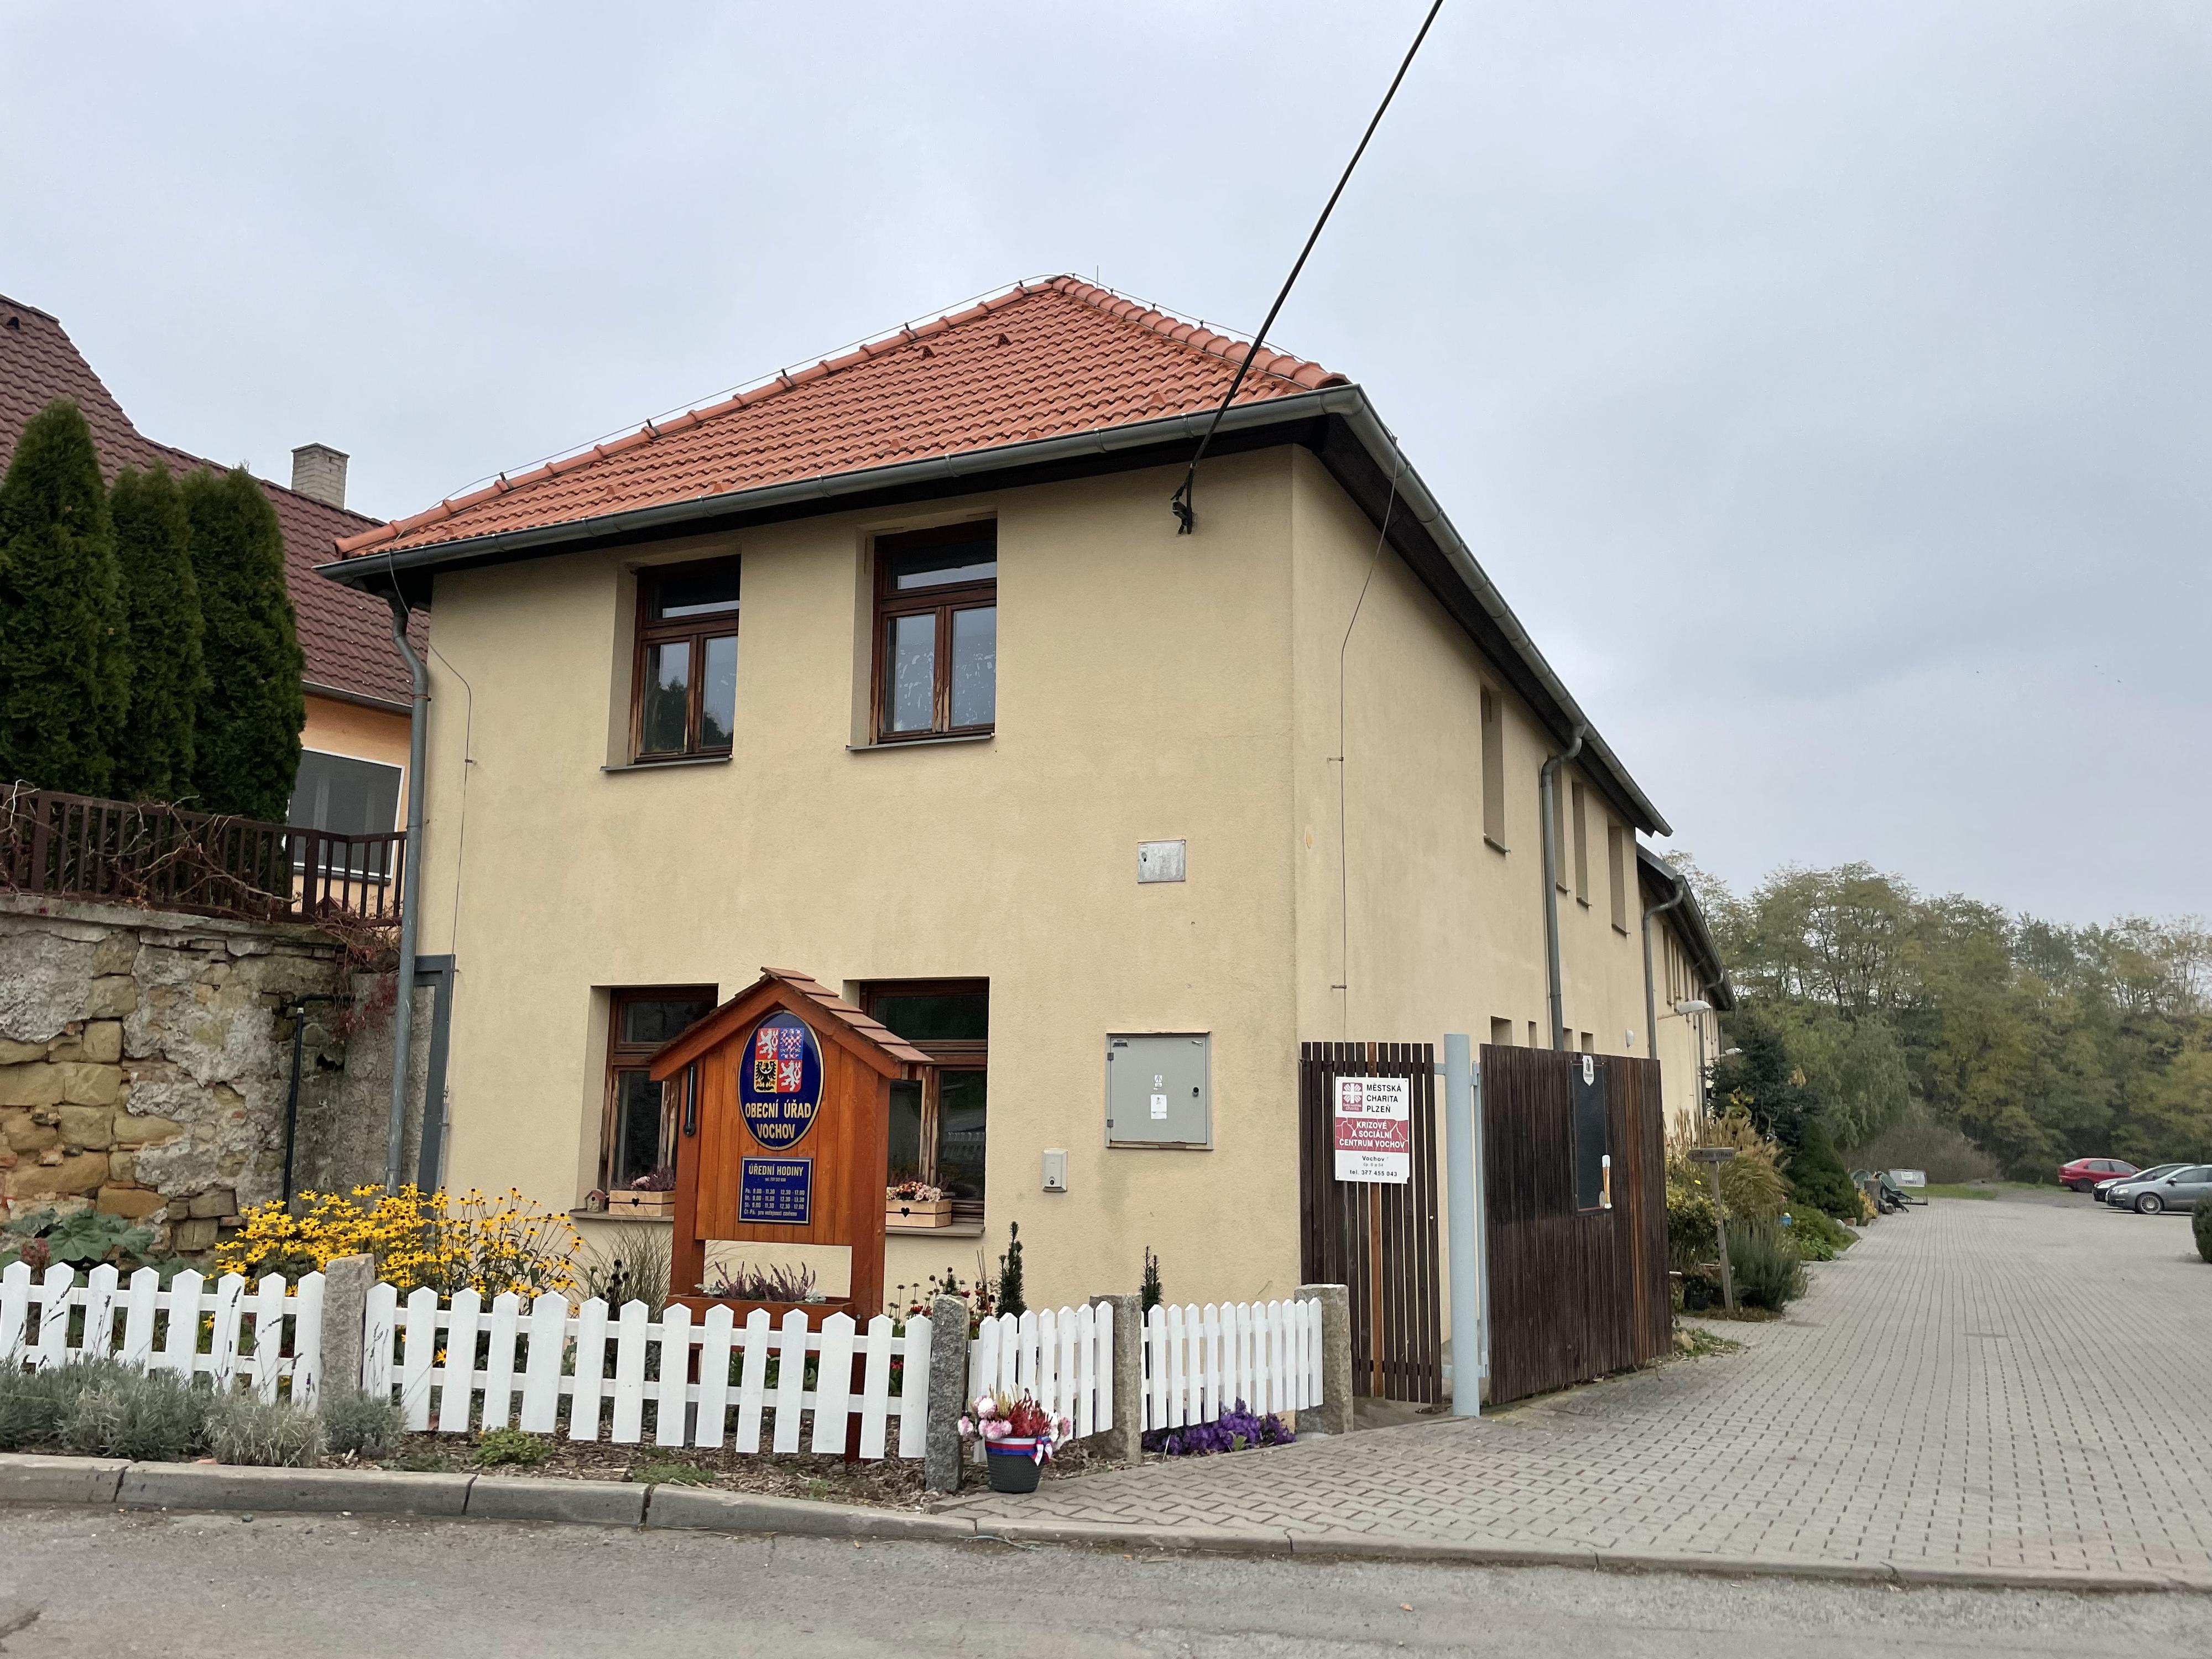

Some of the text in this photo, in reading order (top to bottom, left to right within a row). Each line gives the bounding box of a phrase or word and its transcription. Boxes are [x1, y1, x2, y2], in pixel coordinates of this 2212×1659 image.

[1366, 1083, 1401, 1092] MĚSTSKÁ
[745, 1099, 811, 1118] OBECNÍ ÚŘAD
[1366, 1104, 1391, 1113] PLZEŇ
[757, 1123, 795, 1139] VOCHOV
[1339, 1139, 1373, 1147] CENTRUM
[749, 1164, 804, 1176] ÚŘEDNÍ HODINY
